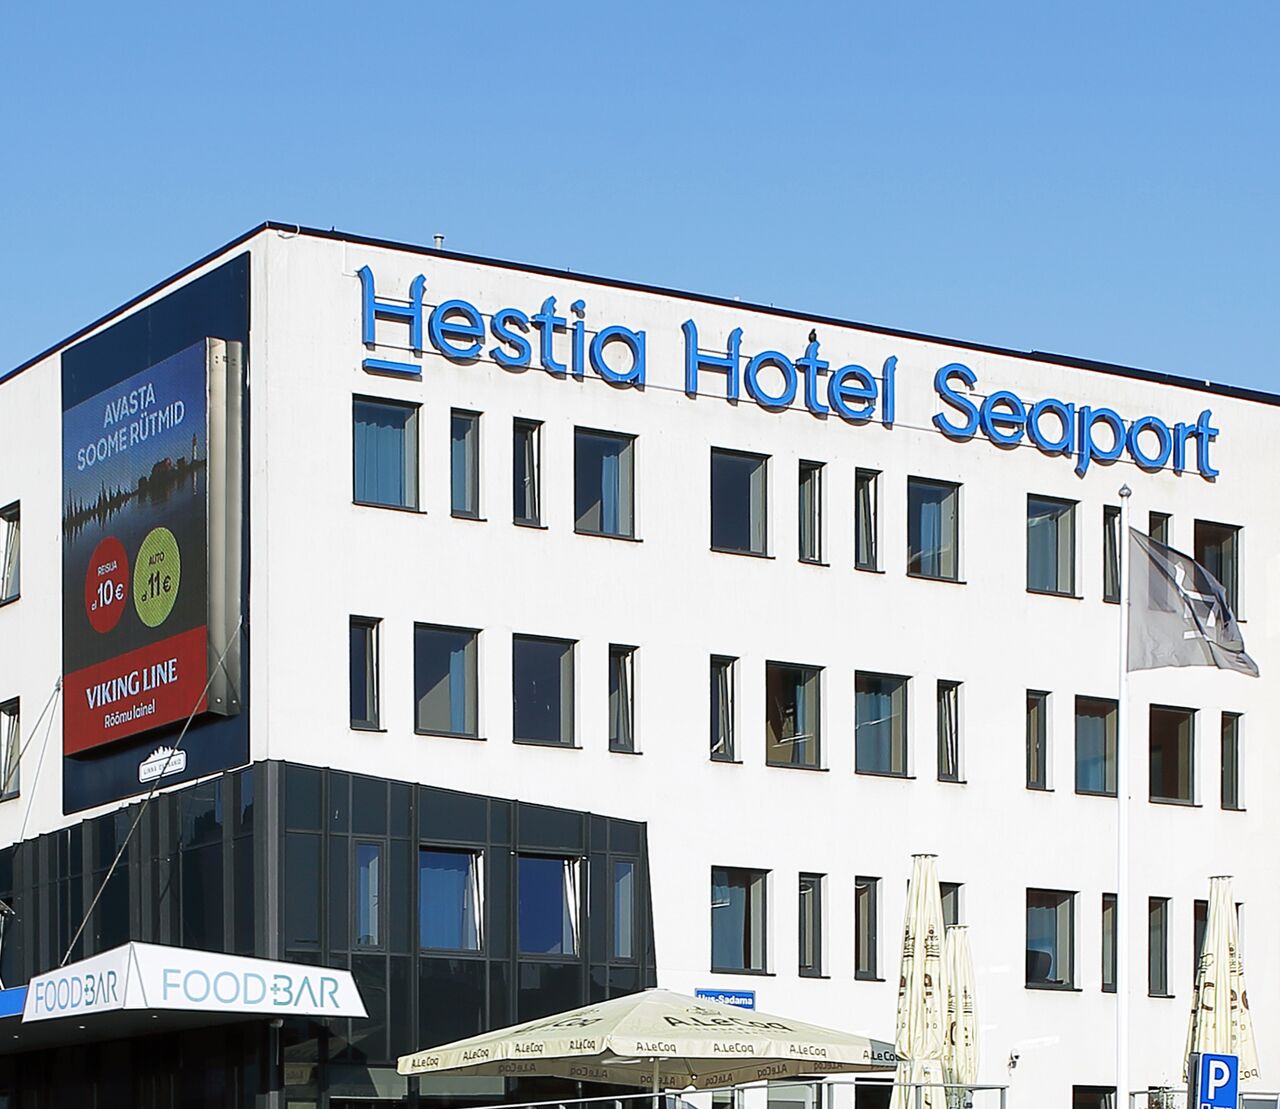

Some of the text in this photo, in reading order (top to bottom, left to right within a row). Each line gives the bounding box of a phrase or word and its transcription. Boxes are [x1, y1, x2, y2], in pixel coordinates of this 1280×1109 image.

[358, 264, 1220, 482] Hestia Hotel Seaport
[104, 383, 156, 428] AVASTA
[77, 400, 185, 471] SOOME RÜTMID
[97, 579, 114, 608] 10
[148, 571, 161, 599] 11
[86, 658, 178, 710] VIKING LINE
[133, 698, 156, 719] lainel
[1208, 1060, 1231, 1099] P
